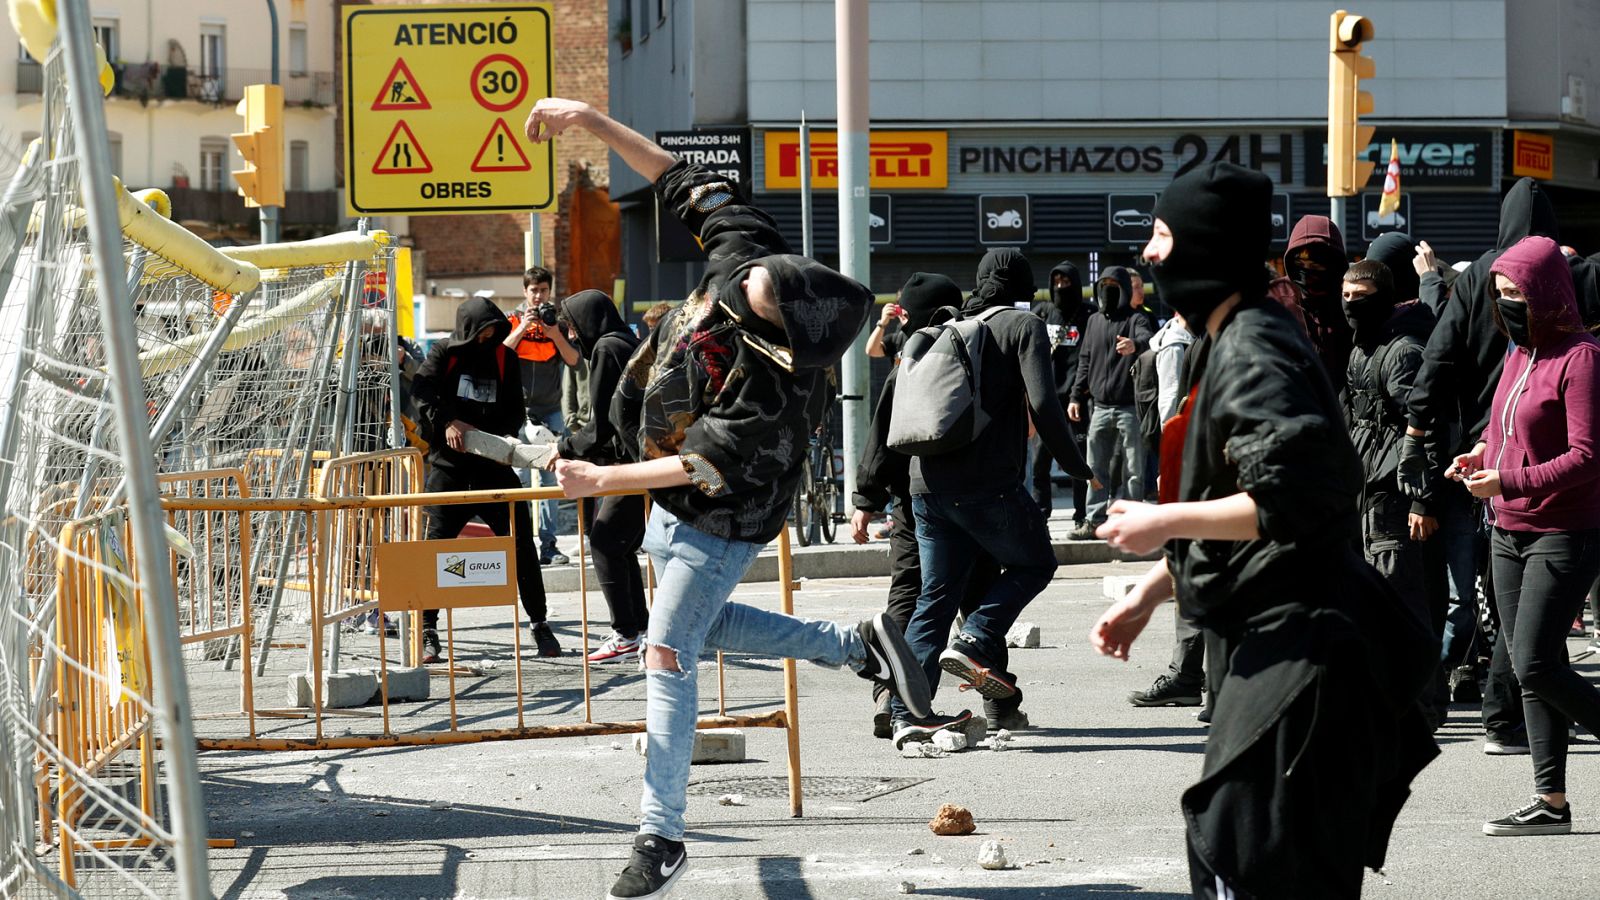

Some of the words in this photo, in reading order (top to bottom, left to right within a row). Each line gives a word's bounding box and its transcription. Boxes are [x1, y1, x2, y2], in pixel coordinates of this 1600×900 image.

[394, 16, 518, 46] ATENCIÓ
[482, 70, 518, 94] 30
[660, 135, 720, 146] PINCHAZOS
[721, 134, 741, 144] 24H
[672, 149, 741, 165] TRADA
[779, 143, 933, 177] PRLLI
[959, 146, 1164, 174] PINCHAZOS
[1173, 133, 1293, 184] 24H
[1516, 139, 1551, 172] PIRELLI
[1417, 168, 1425, 177] Y
[1427, 168, 1475, 177] SERVICIOS
[420, 181, 492, 199] OBRES
[469, 562, 502, 571] GRUAS
